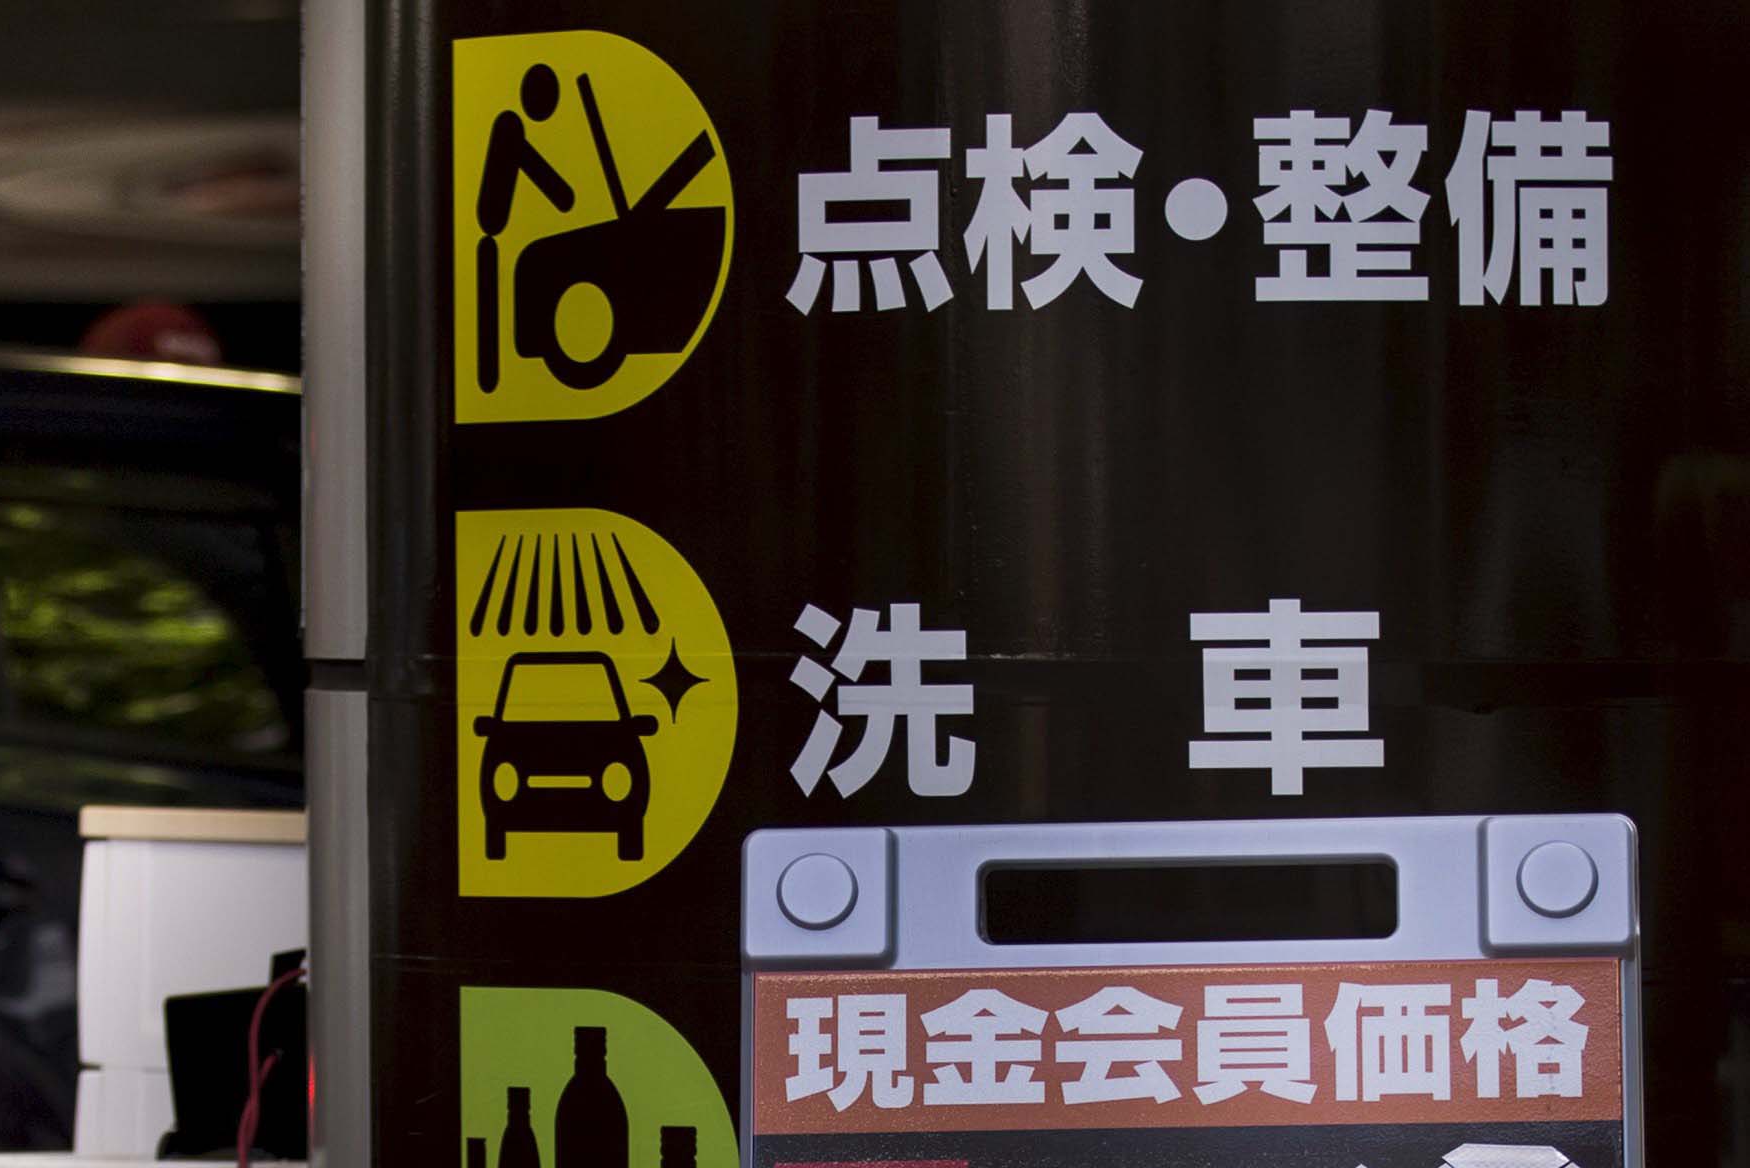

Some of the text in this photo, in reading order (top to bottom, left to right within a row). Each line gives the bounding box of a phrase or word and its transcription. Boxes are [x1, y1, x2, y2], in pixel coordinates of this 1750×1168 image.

[785, 109, 1613, 315] 点検・整備
[784, 978, 1590, 1113] 現金会員価格
